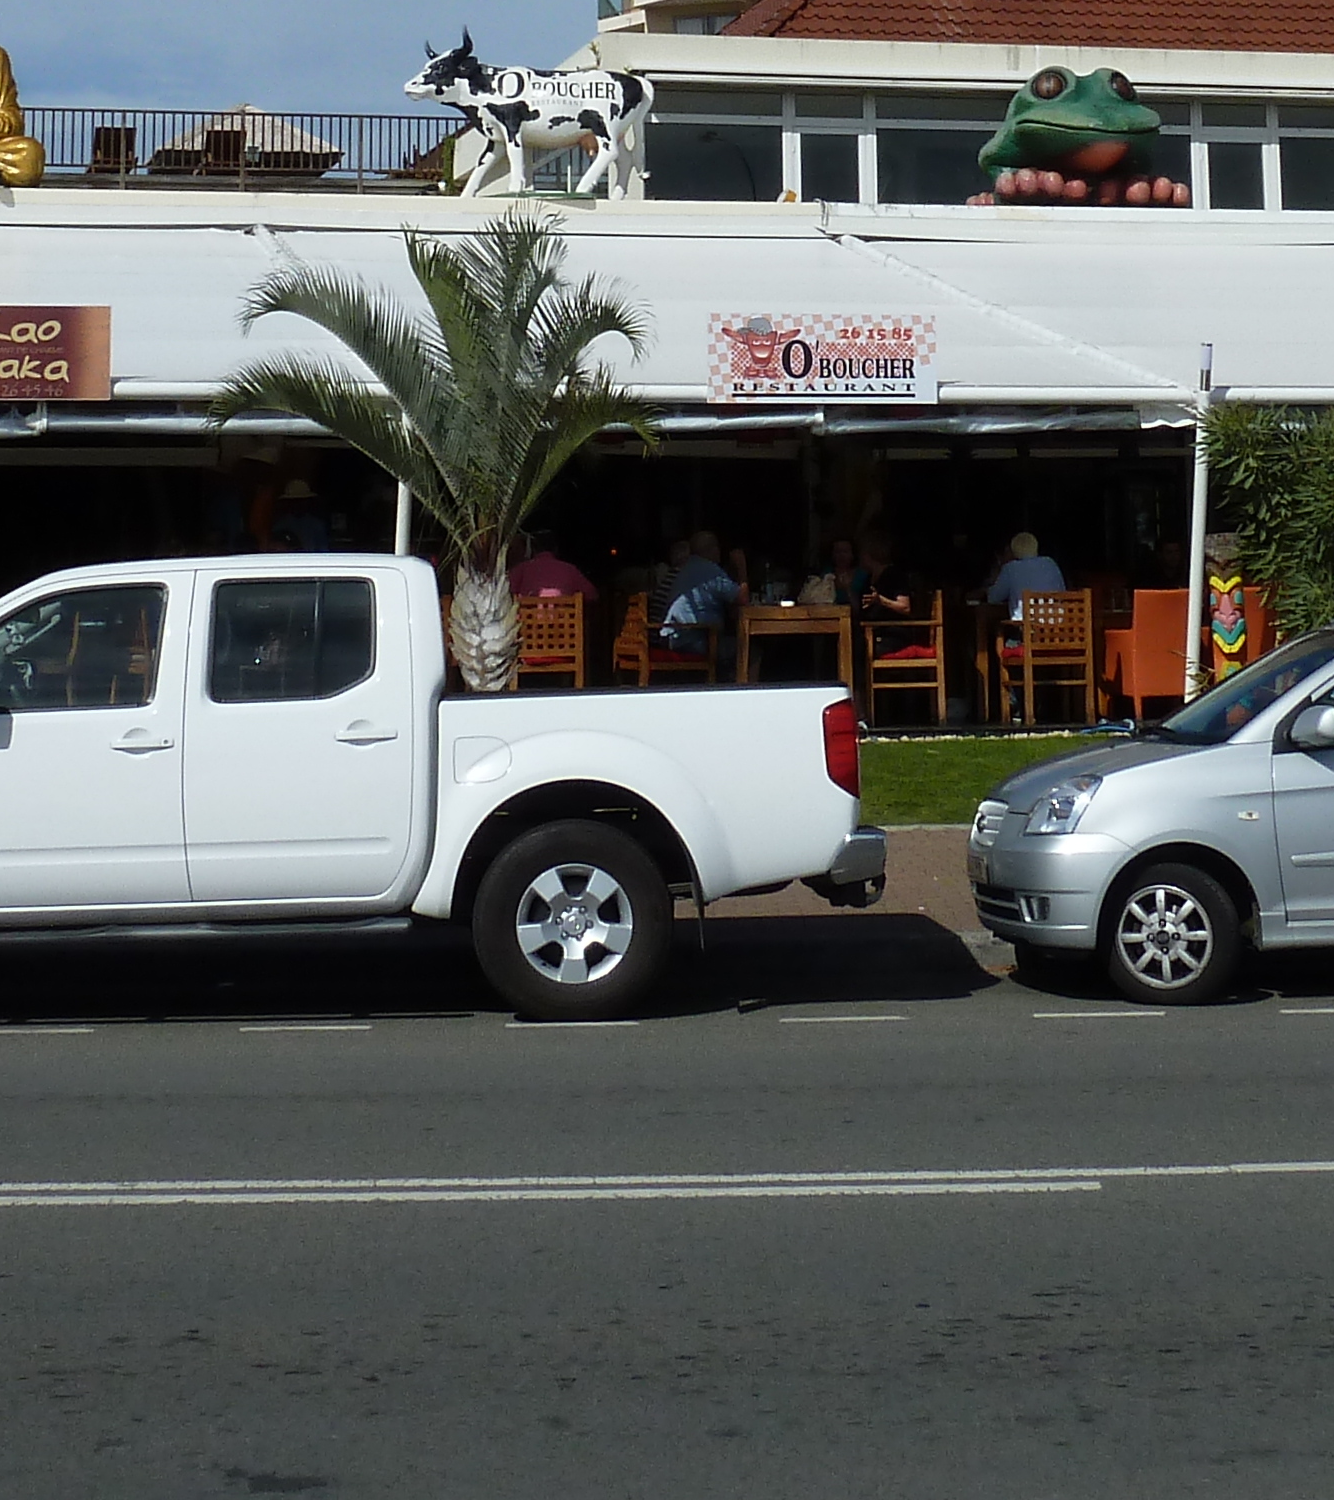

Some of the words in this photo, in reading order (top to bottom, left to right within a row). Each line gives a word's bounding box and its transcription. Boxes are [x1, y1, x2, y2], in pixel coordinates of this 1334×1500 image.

[839, 327, 861, 340] 26
[866, 328, 886, 341] 15
[892, 327, 913, 341] 85
[732, 383, 916, 392] RESTAURANT
